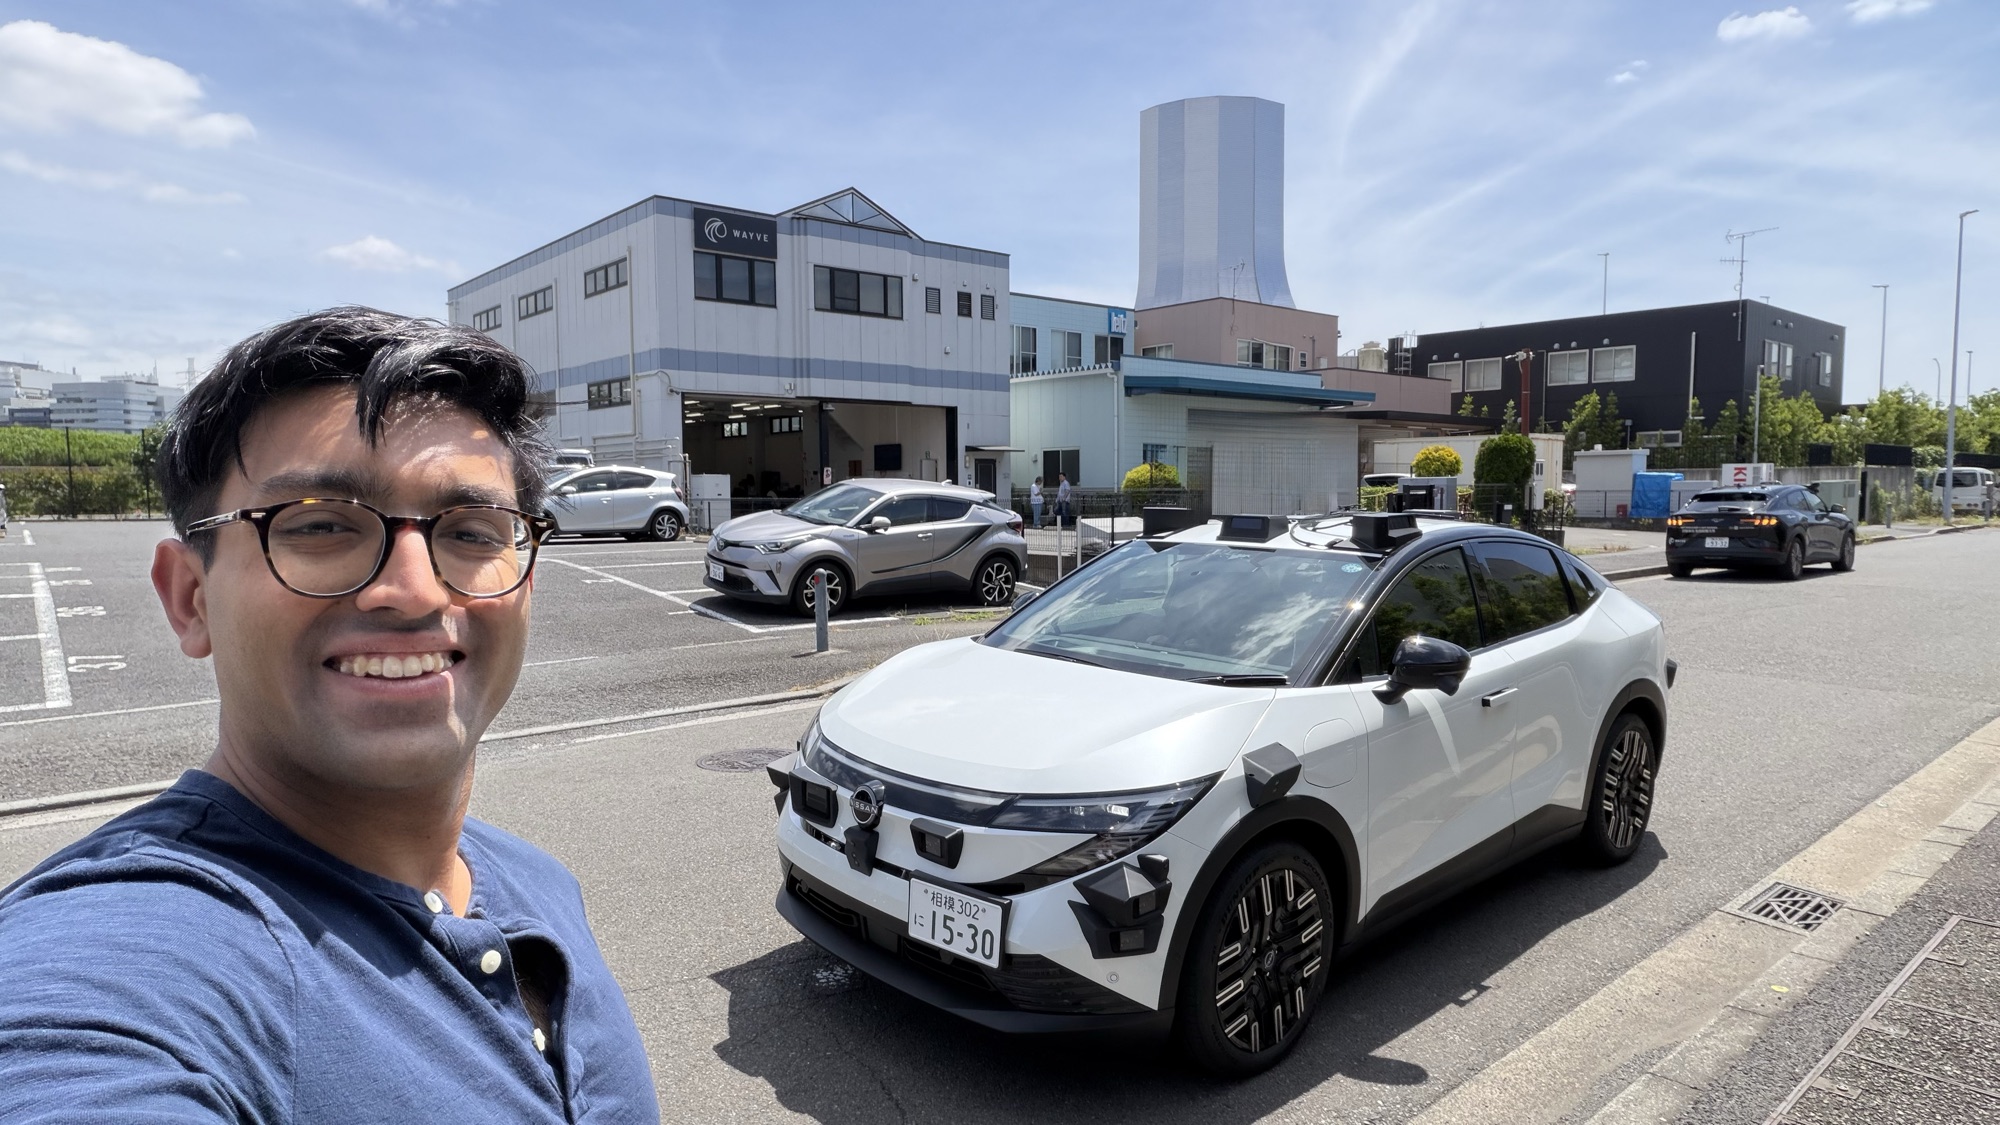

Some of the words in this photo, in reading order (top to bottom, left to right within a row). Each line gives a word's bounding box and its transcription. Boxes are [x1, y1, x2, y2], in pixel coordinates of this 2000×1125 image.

[732, 229, 769, 243] WAYVE
[1734, 466, 1747, 486] KI
[67, 654, 127, 673] 31
[914, 912, 925, 928] に
[931, 910, 995, 960] 15-30
